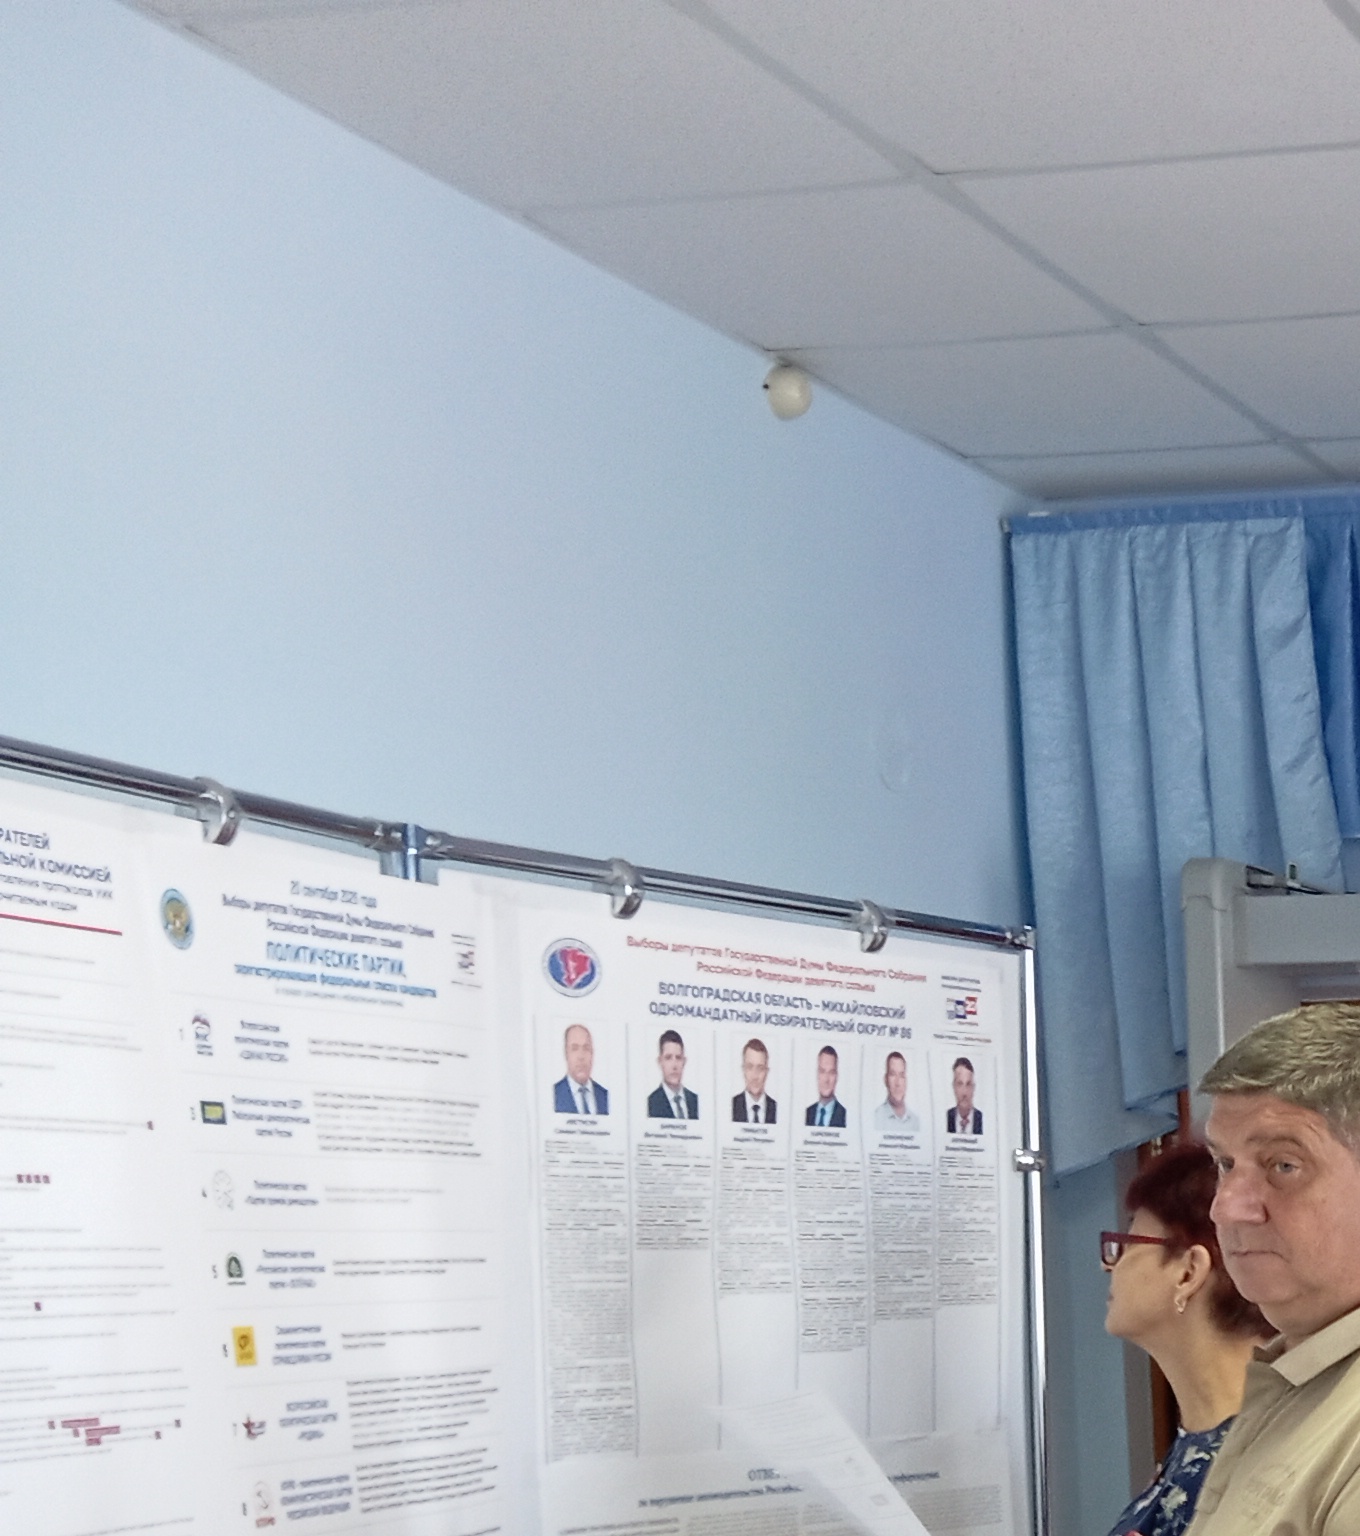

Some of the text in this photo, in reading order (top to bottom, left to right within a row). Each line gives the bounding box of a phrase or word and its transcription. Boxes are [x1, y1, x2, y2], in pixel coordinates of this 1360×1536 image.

[658, 981, 762, 1005] ВОЛГОГРАДСКАЯ
[763, 993, 813, 1010] ОБЛАСТЬ
[821, 999, 906, 1019] МИХАЙЛОВСКИЙ
[649, 1001, 762, 1024] ОДНОМАНДАТНЫЙ
[764, 1012, 855, 1033] ИЗБИРАТЕЛЬНЫЙ
[856, 1022, 888, 1036] ОКРУГ
